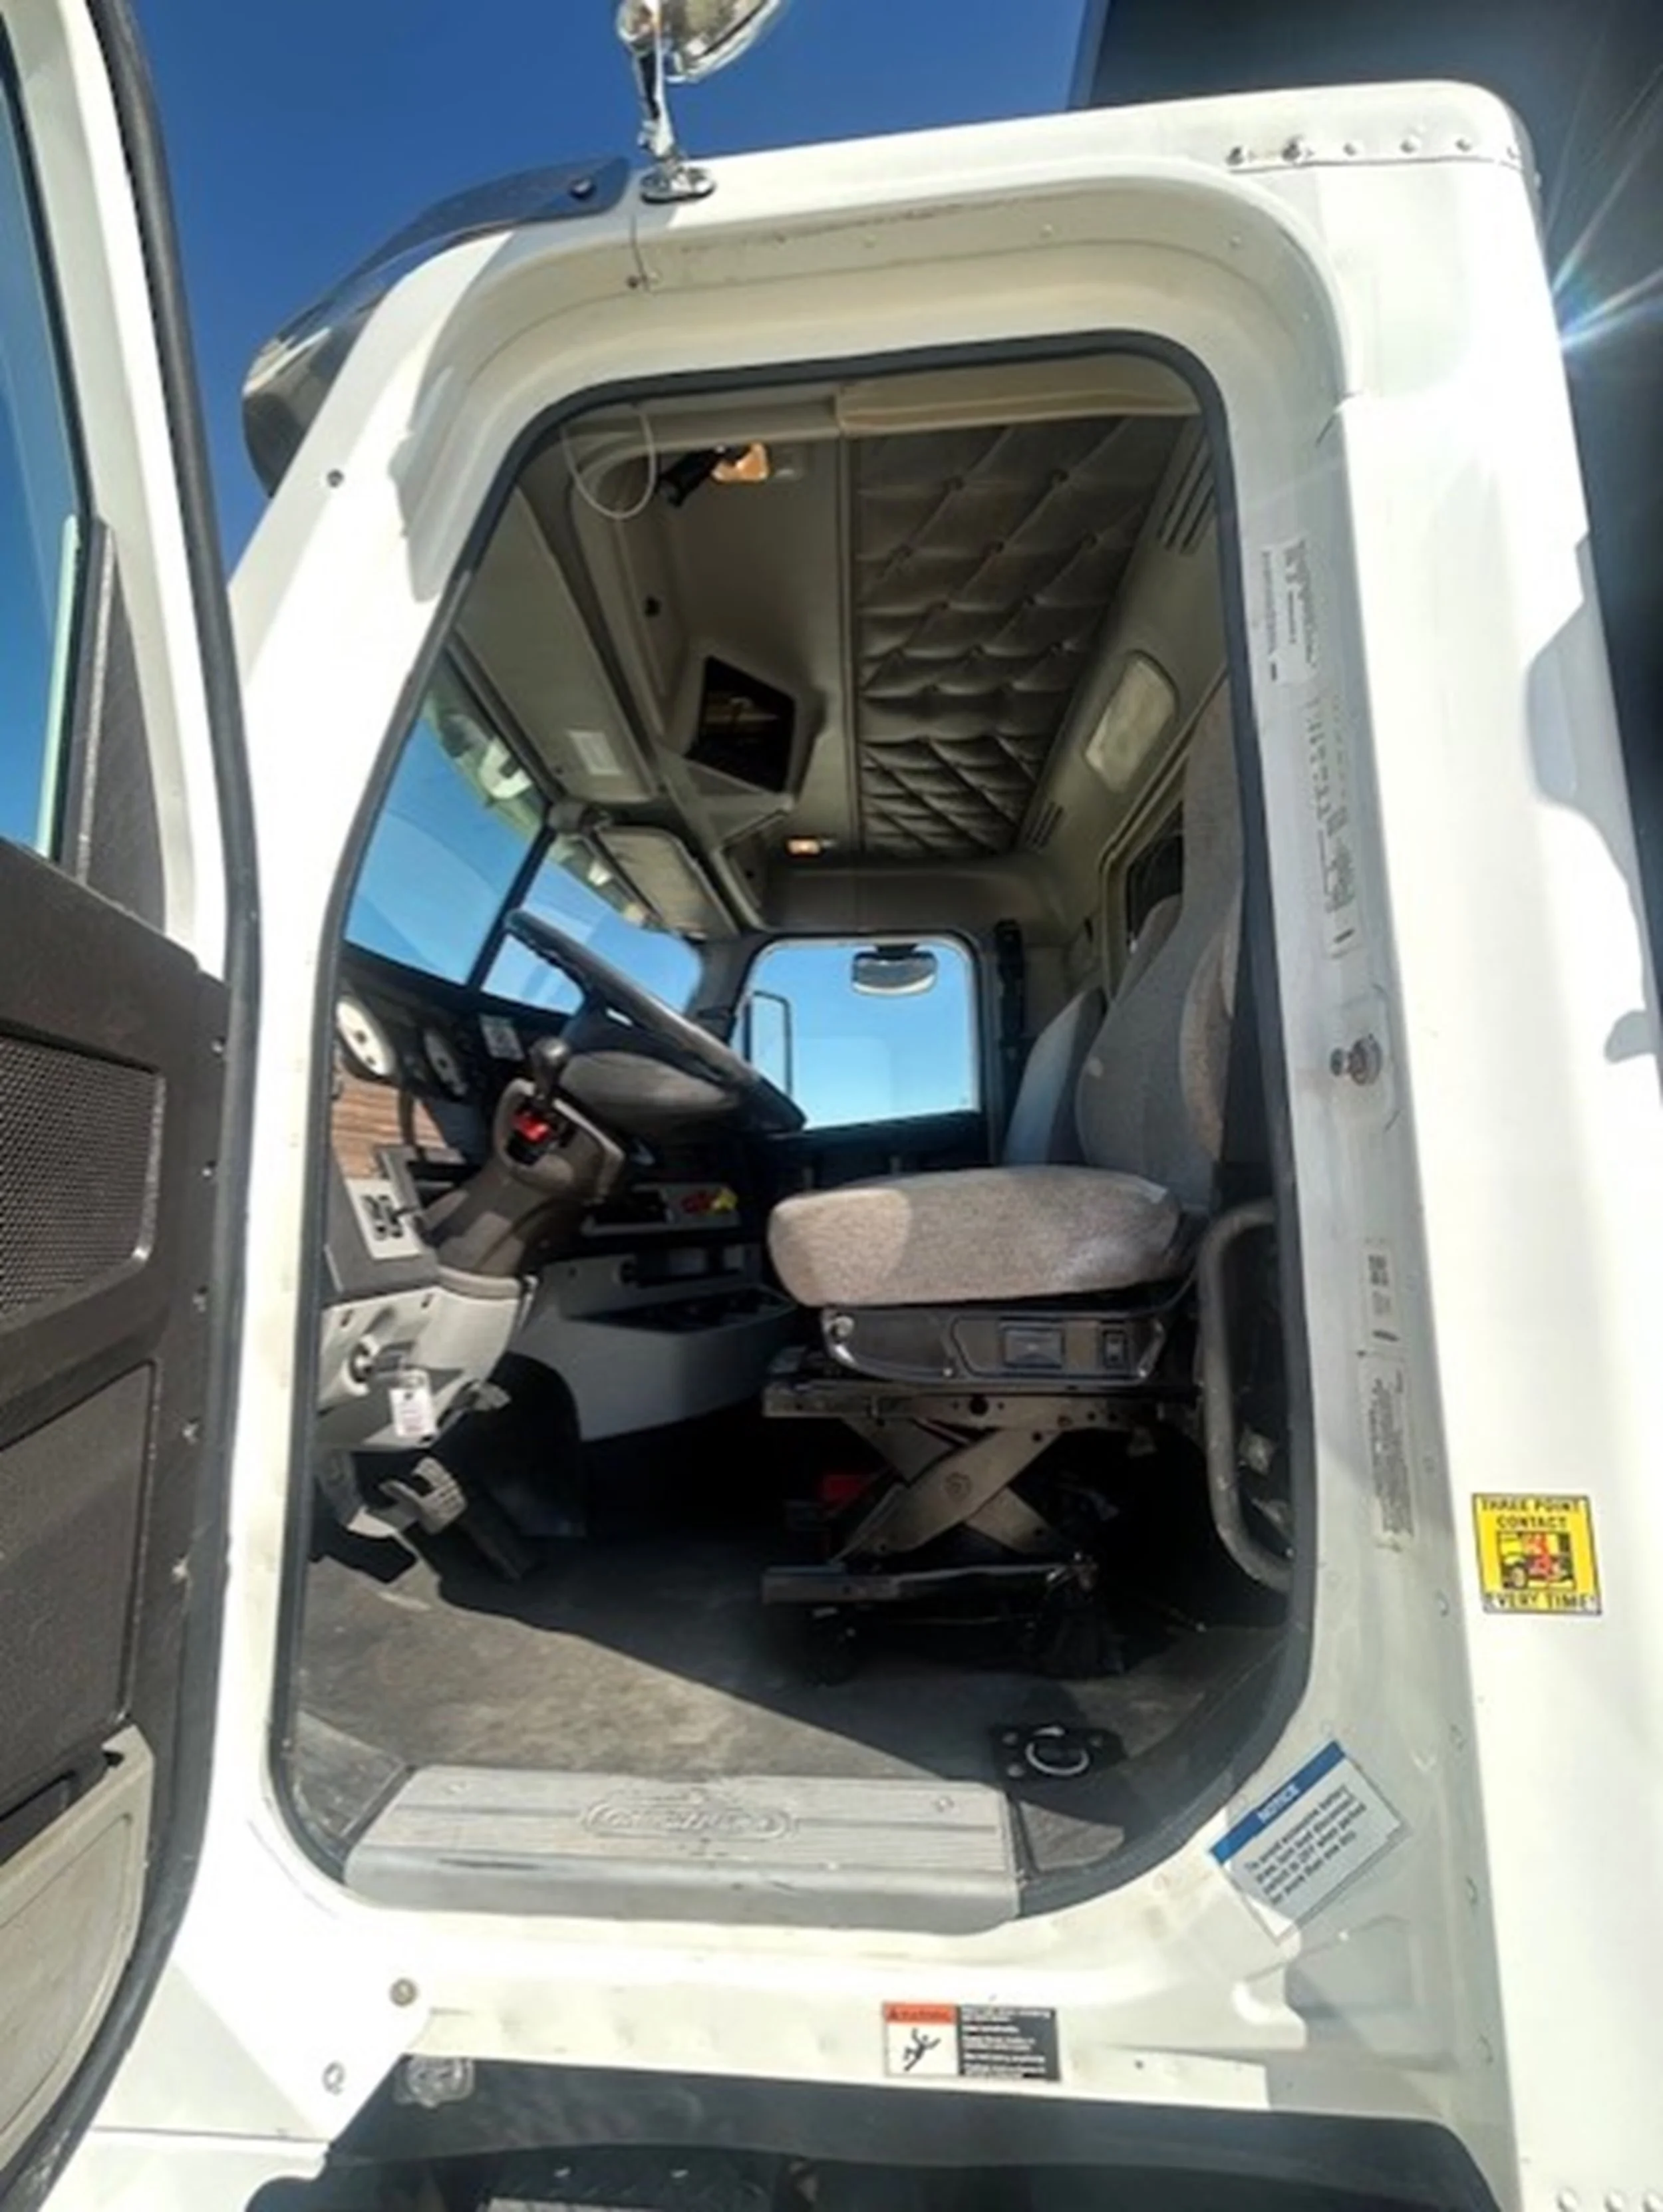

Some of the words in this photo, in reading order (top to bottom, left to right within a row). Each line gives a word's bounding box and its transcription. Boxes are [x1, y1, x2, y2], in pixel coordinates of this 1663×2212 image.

[1482, 1497, 1527, 1511] THREE
[1534, 1498, 1581, 1513] POINT
[1496, 1516, 1567, 1529] CONTACT
[1485, 1591, 1538, 1607] EVERY
[1547, 1592, 1596, 1608] TIME
[1257, 1783, 1299, 1822] NOTICE
